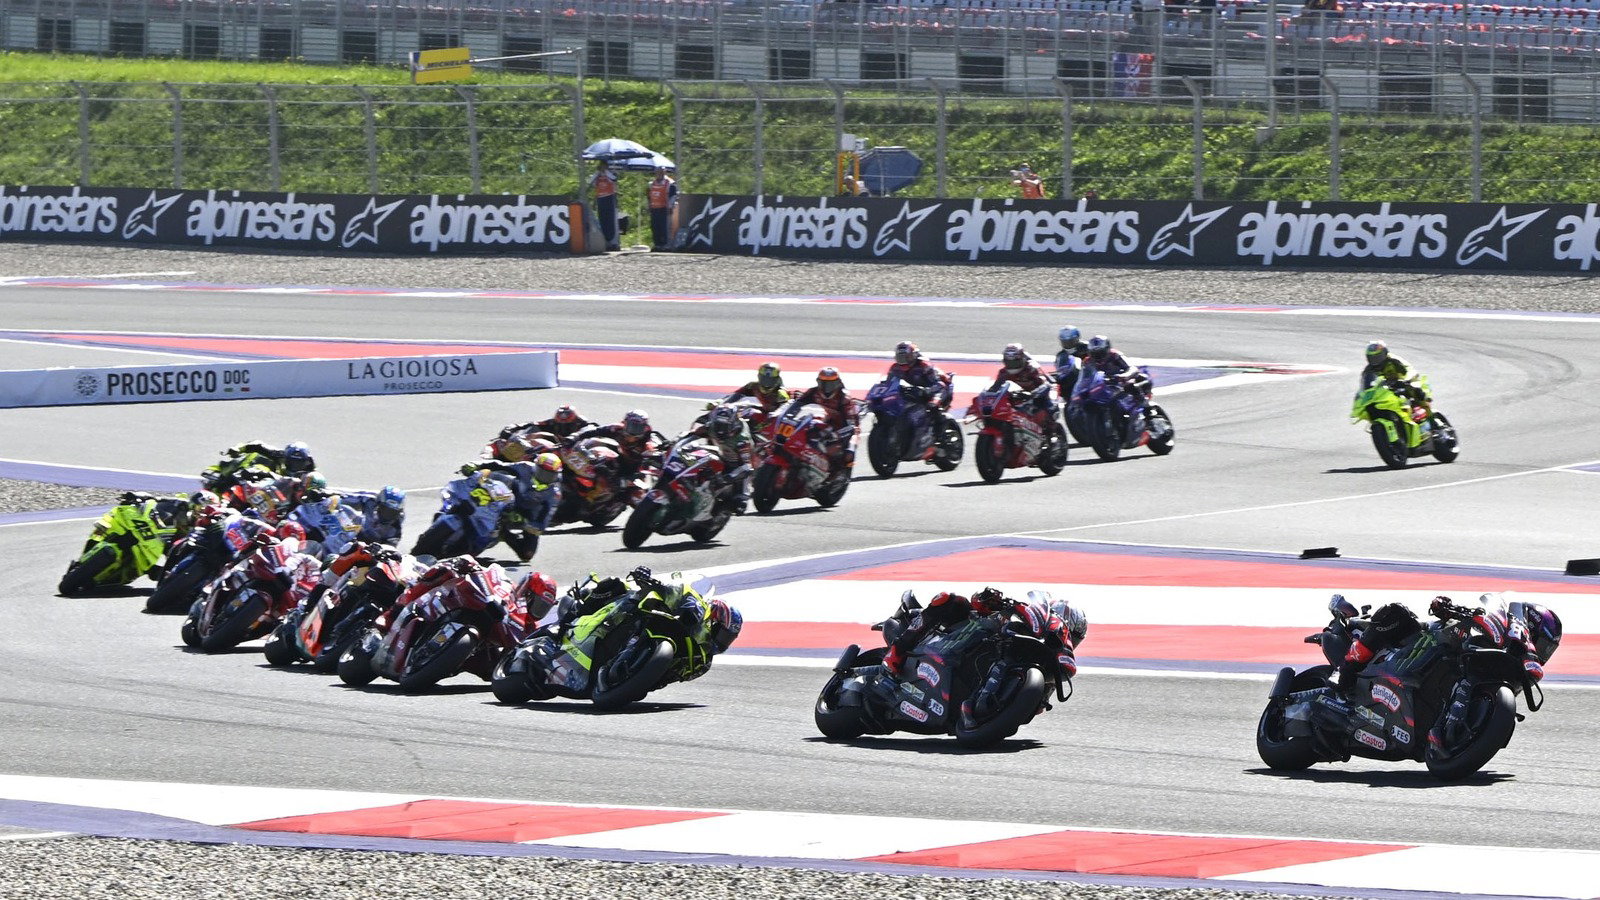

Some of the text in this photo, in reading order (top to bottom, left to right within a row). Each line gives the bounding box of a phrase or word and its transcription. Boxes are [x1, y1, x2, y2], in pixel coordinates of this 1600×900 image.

[0, 185, 117, 233] pinestars
[186, 189, 336, 245] alpinestars
[410, 194, 571, 252] alpinestars
[738, 194, 868, 255] alpinestars
[945, 197, 1140, 261] alpinestars
[1237, 201, 1447, 265] alpinestars
[107, 369, 250, 396] PROSECCO DOC
[384, 380, 443, 390] PROSECCO
[1361, 732, 1386, 750] Castrol
